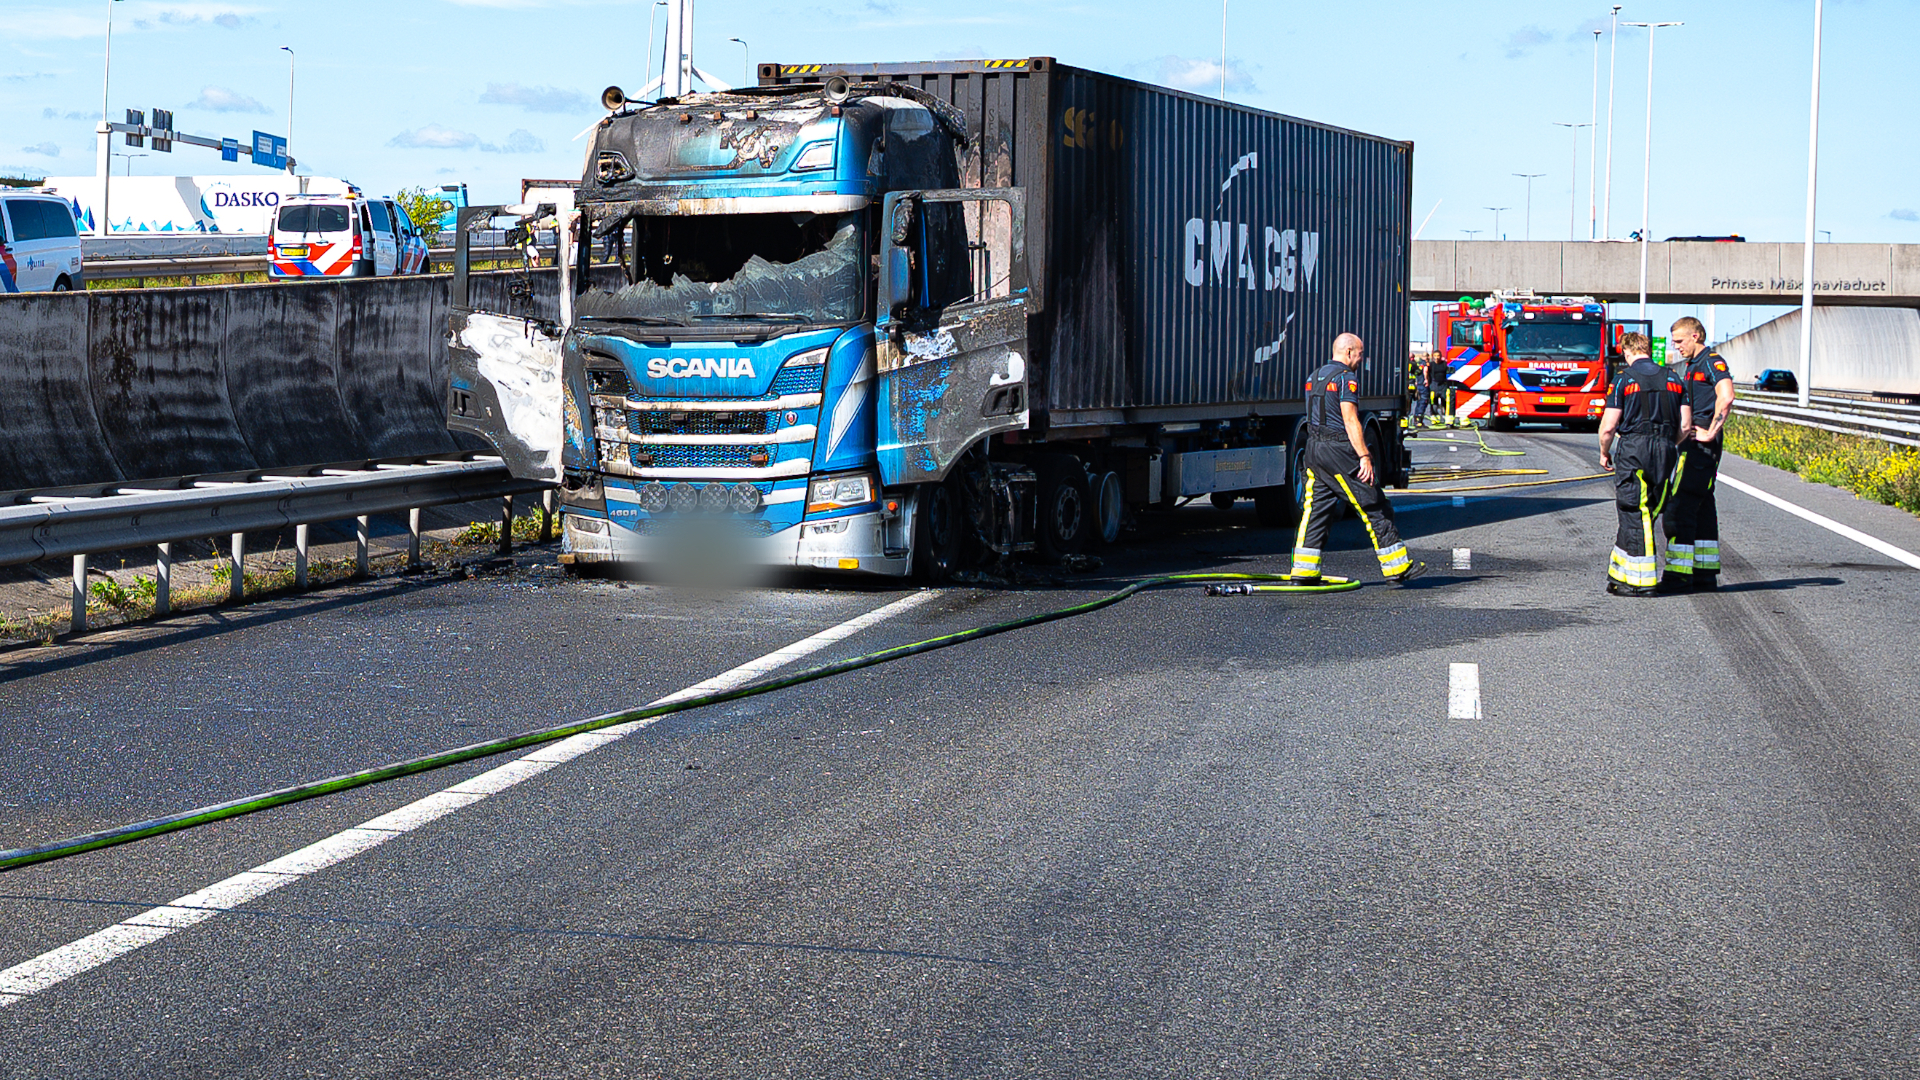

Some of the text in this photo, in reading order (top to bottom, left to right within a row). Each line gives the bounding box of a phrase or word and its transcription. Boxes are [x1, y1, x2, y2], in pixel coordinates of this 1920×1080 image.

[215, 191, 279, 207] DASKO
[1185, 217, 1319, 293] CMA CGM
[1711, 278, 1764, 290] Prinses
[647, 358, 757, 378] SCANIA
